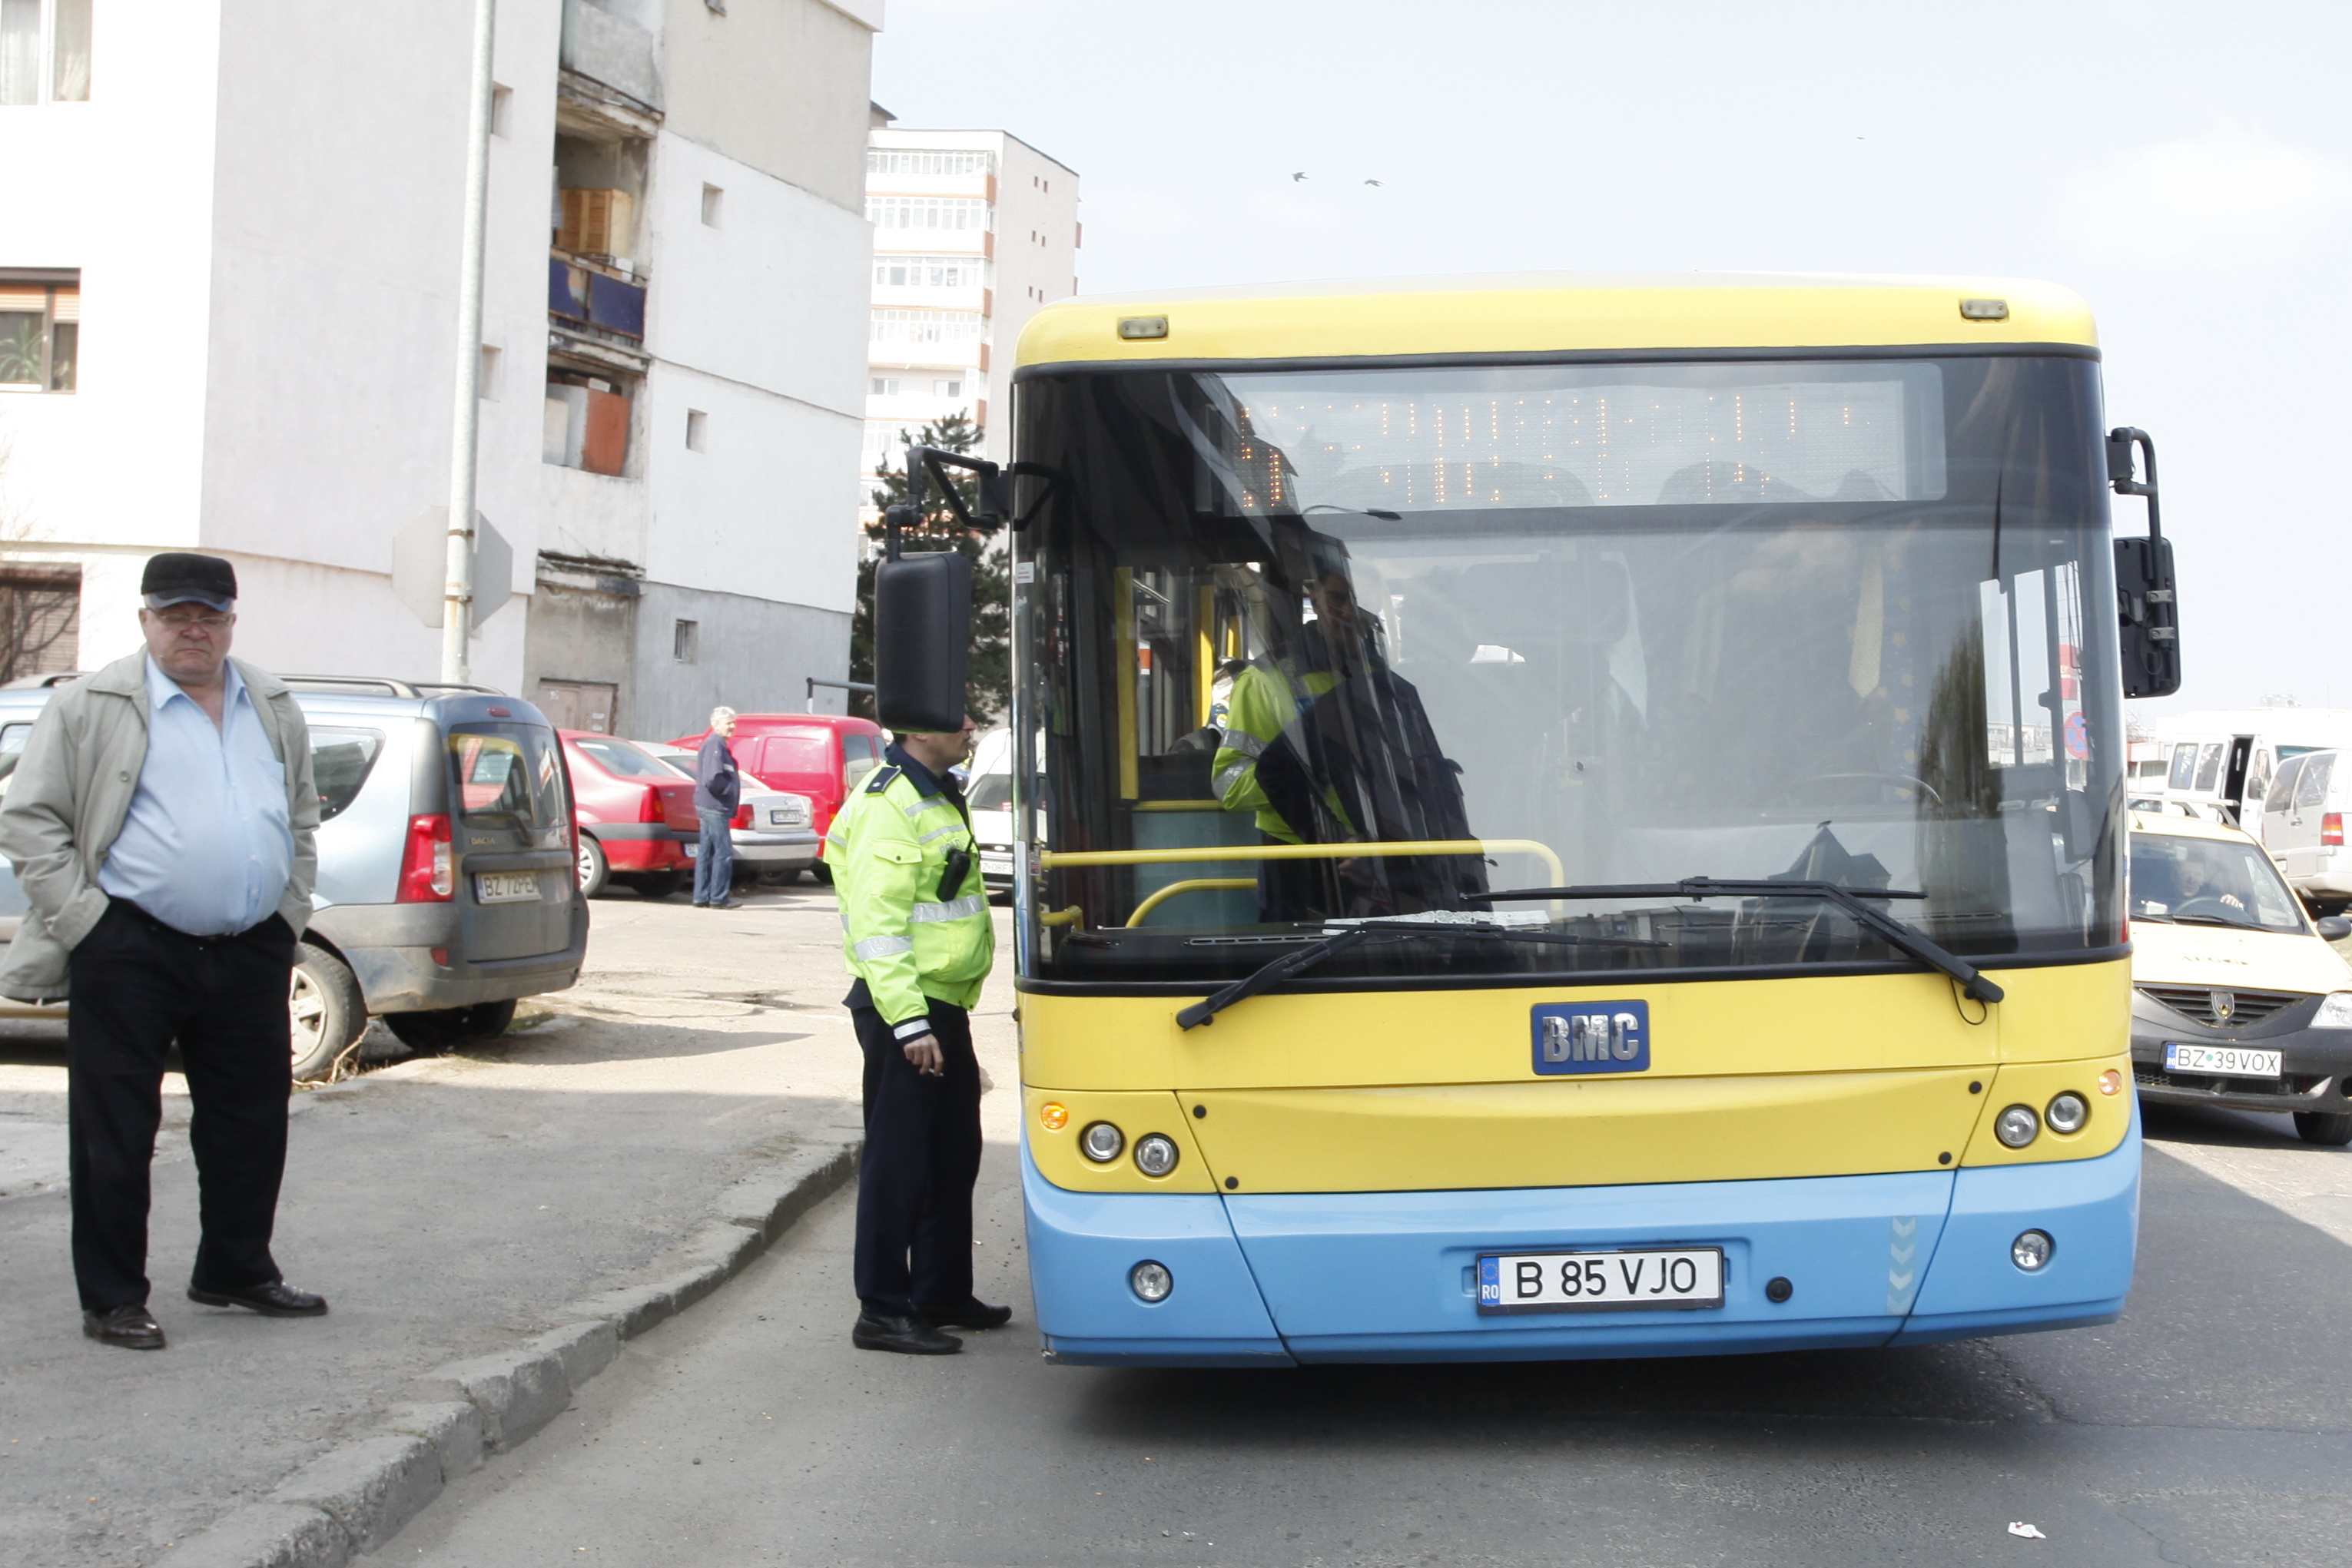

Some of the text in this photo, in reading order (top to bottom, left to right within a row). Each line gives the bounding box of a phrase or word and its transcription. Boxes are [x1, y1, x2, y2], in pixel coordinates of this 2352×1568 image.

[1542, 1013, 1639, 1063] BMC
[2178, 1048, 2205, 1068] BZ
[2214, 1051, 2236, 1069] 39
[2239, 1053, 2278, 1072] VOX
[1481, 1257, 1697, 1300] RO B 85 VJO
